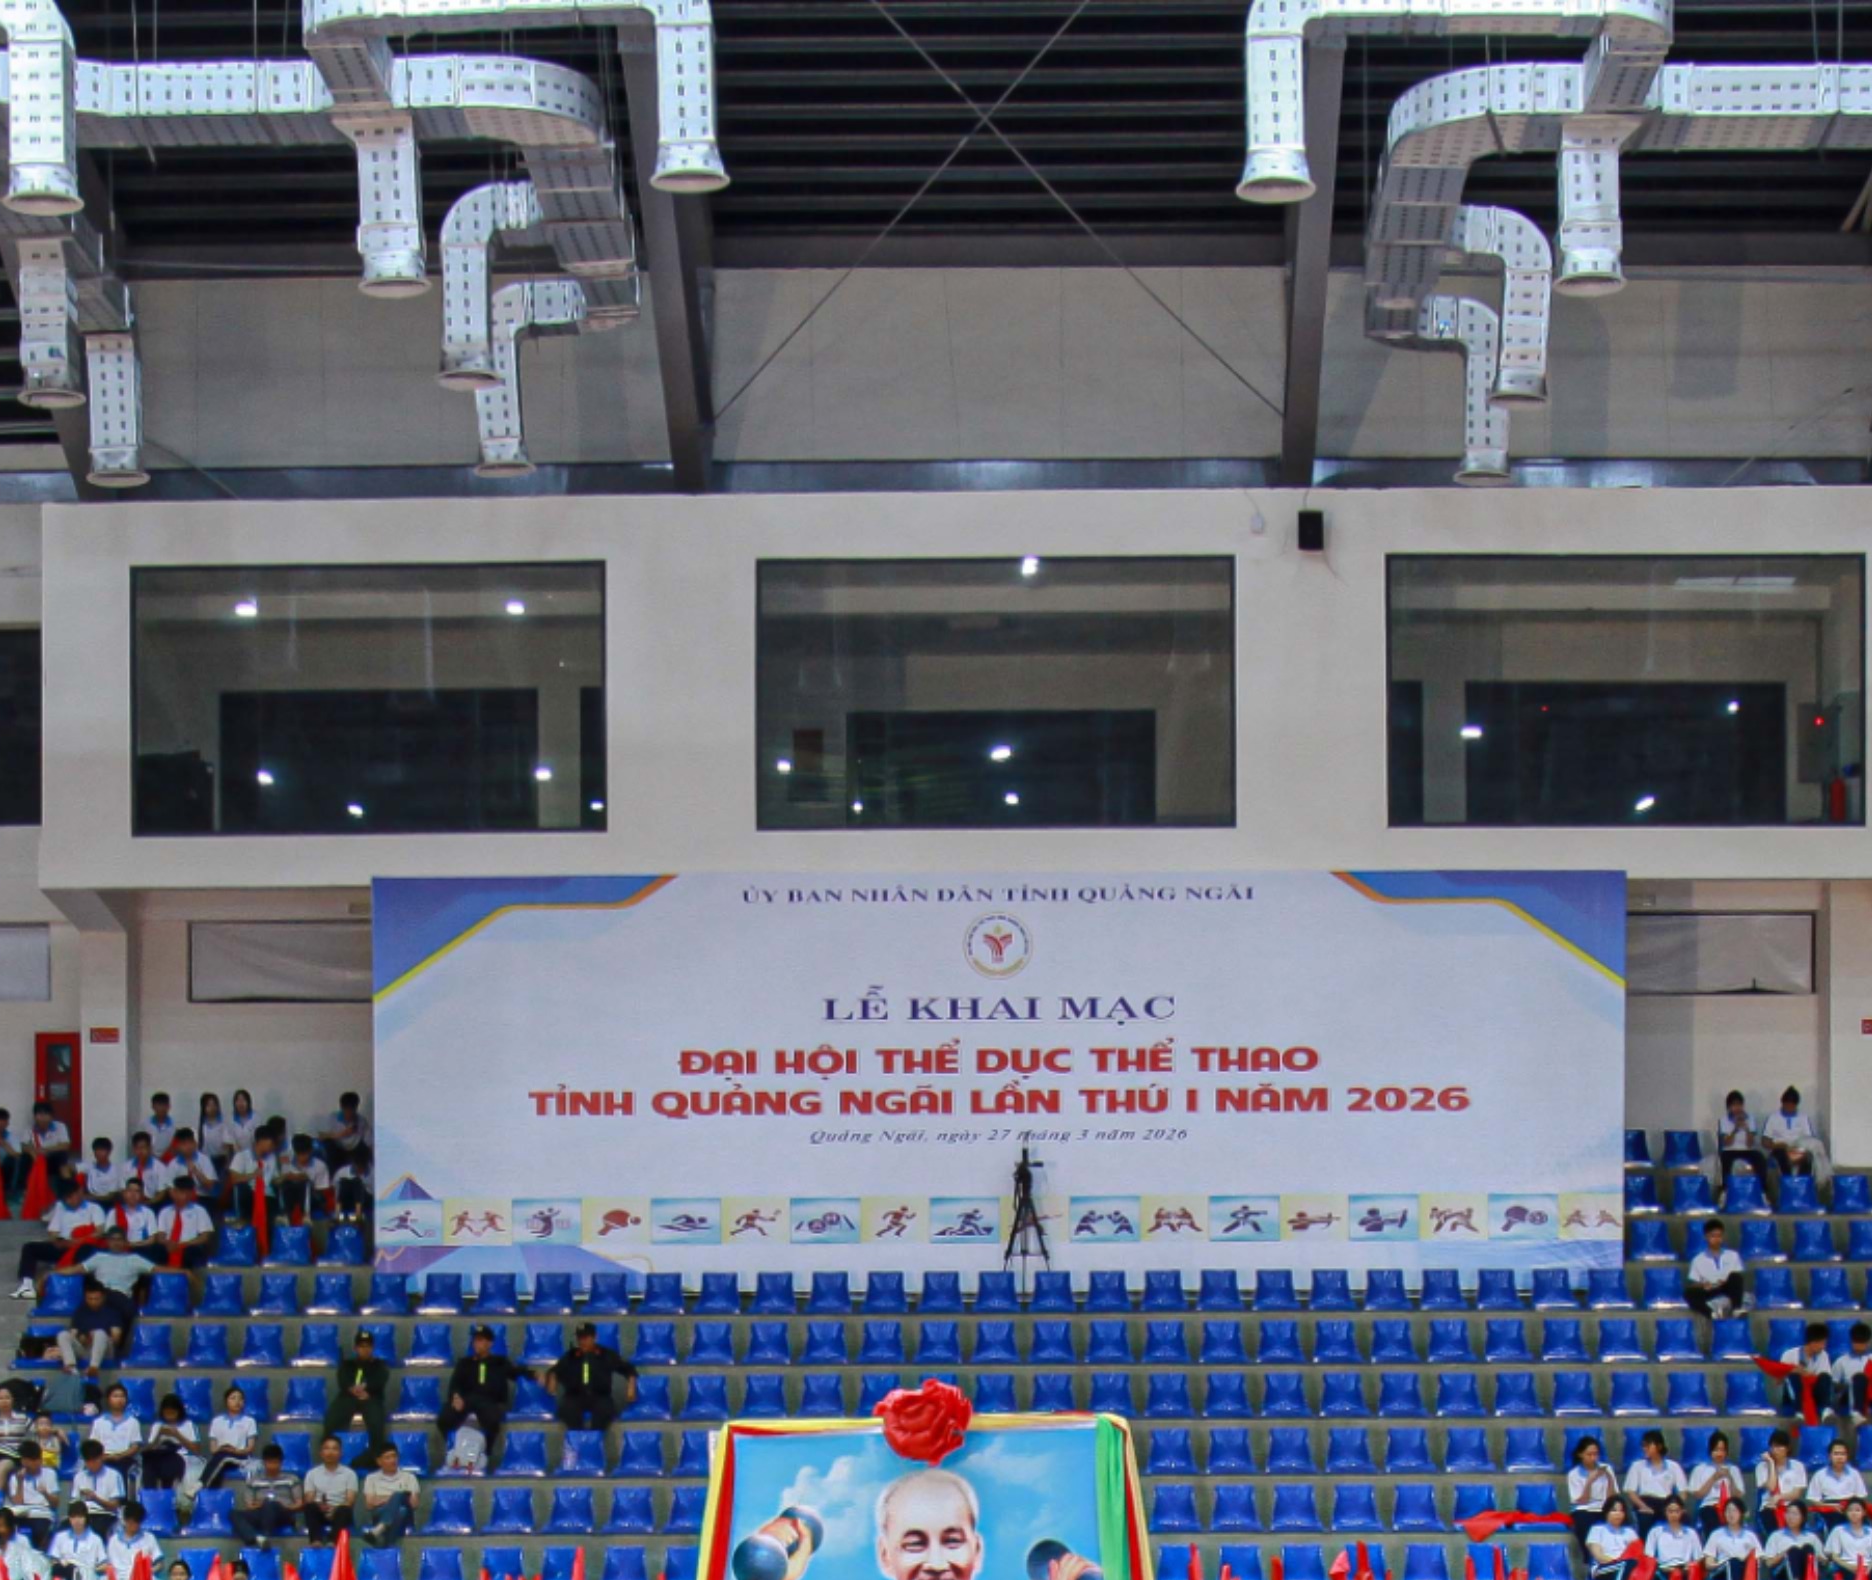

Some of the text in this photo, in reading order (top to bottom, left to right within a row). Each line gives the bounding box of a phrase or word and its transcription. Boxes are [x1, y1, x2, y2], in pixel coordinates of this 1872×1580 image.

[742, 882, 1254, 904] ỦY BAN NHÂN DÂN TỈNH QUẢNG NGÃI
[822, 984, 1175, 1026] LỄ KHAI MẠC
[678, 1037, 1320, 1081] ĐẠI HỘI THỂ DỤC THỂ THAO
[528, 1079, 1471, 1119] TỈNH QUẢNG NGÃI LẦN THỨ I NĂM 2026
[936, 1129, 982, 1145] ngày
[987, 1128, 1011, 1142] 27
[1077, 1128, 1090, 1142] 3
[1094, 1129, 1136, 1142] năm
[1142, 1128, 1189, 1142] 2026
